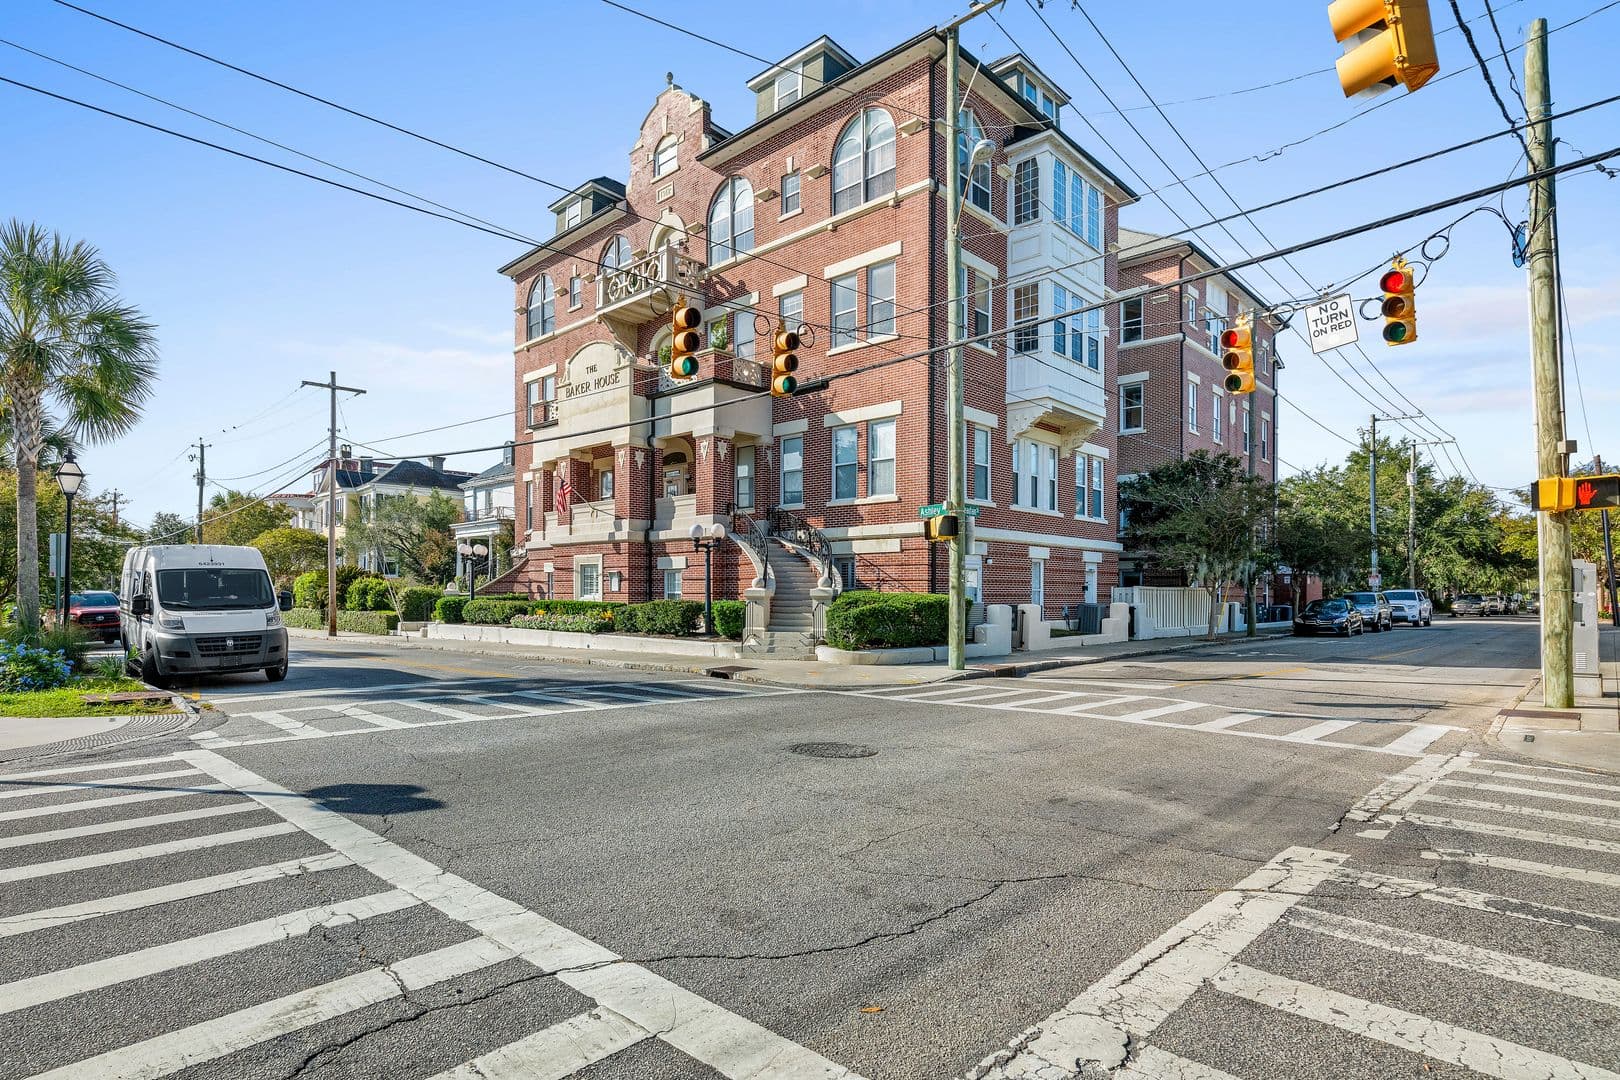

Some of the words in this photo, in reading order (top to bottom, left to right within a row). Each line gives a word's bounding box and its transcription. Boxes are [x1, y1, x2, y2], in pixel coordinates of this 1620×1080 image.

[1319, 301, 1339, 315] NO
[1312, 308, 1349, 328] TURN
[1313, 327, 1328, 338] ON
[1330, 319, 1353, 332] RED
[585, 364, 598, 375] THE
[565, 381, 592, 398] BAKER
[594, 371, 621, 390] HOUSE
[920, 506, 941, 517] Ashley
